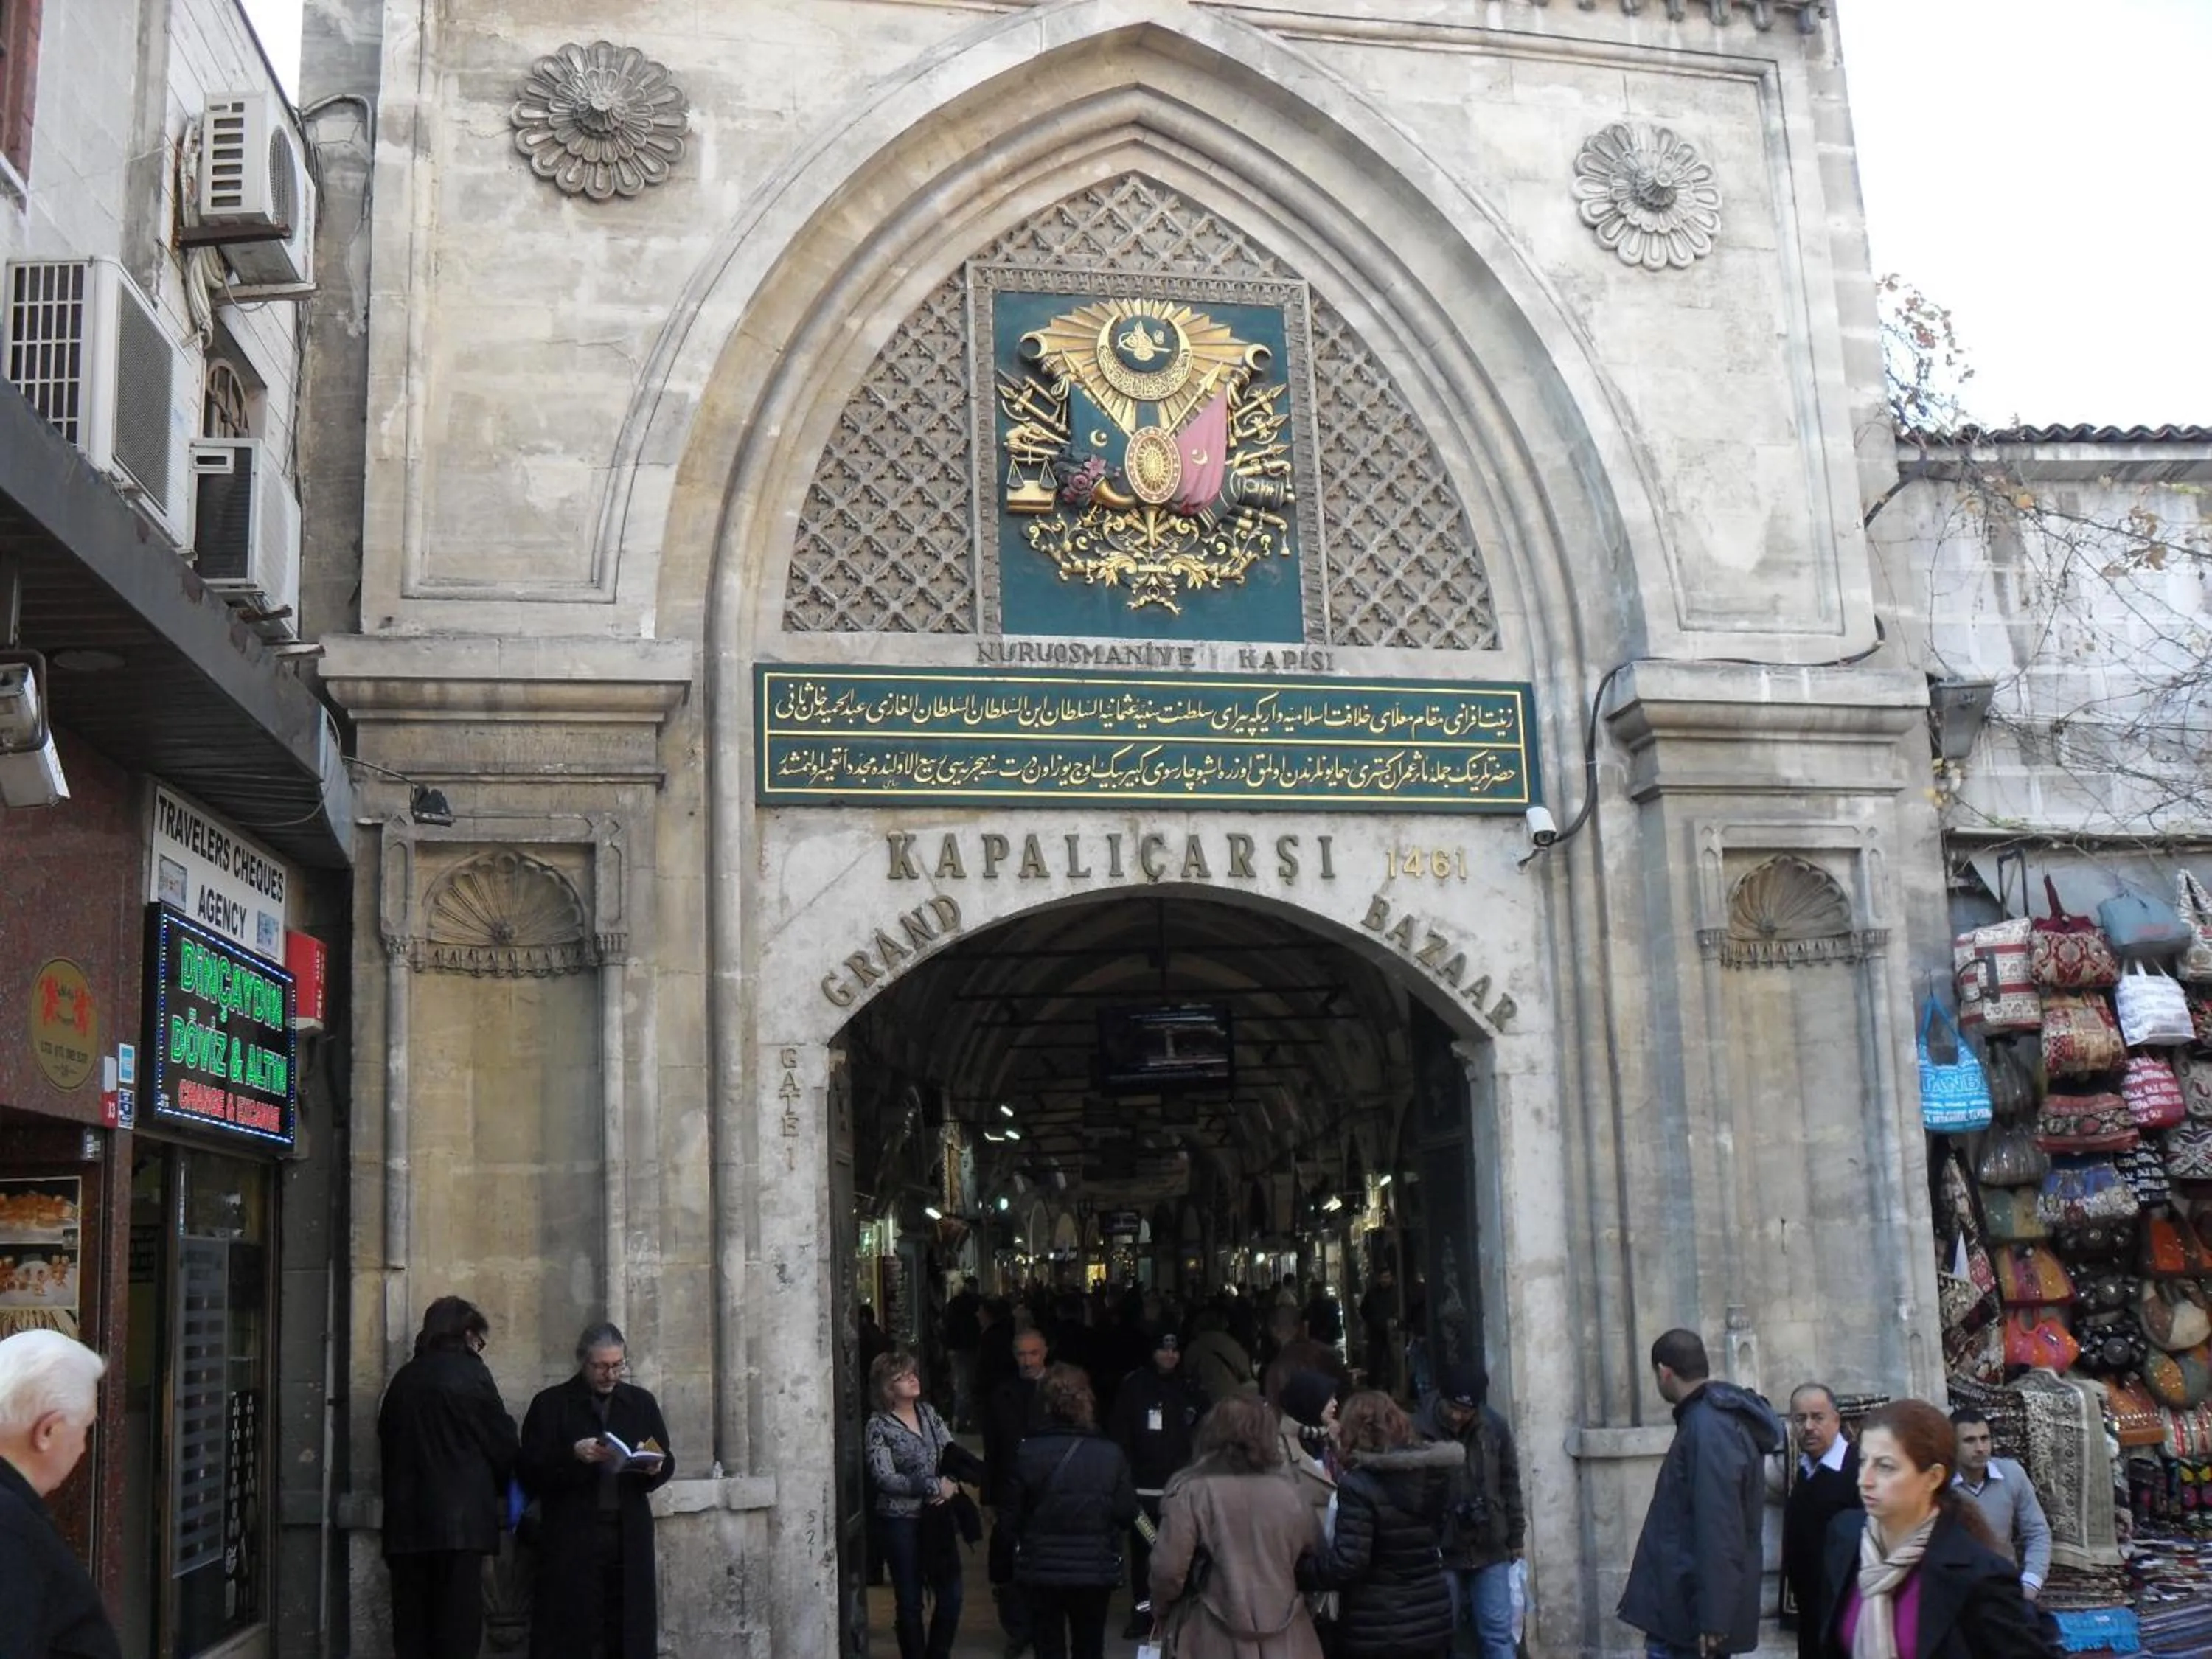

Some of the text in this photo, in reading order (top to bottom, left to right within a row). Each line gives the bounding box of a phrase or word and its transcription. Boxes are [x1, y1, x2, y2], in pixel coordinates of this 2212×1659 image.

[976, 641, 1196, 667] NURUOSMANİYE
[158, 795, 284, 904] TRAVELERS CHEQUES
[887, 832, 1470, 885] KAPALIÇARŞI 1461
[197, 885, 248, 939] AGENCY
[821, 893, 1518, 1033] GRAND BAZAAR
[170, 1007, 228, 1078] DÖVİZ
[229, 1037, 243, 1084] &
[245, 1043, 288, 1098] ALTIN
[226, 1092, 235, 1121] &
[778, 1048, 801, 1138] GATE
